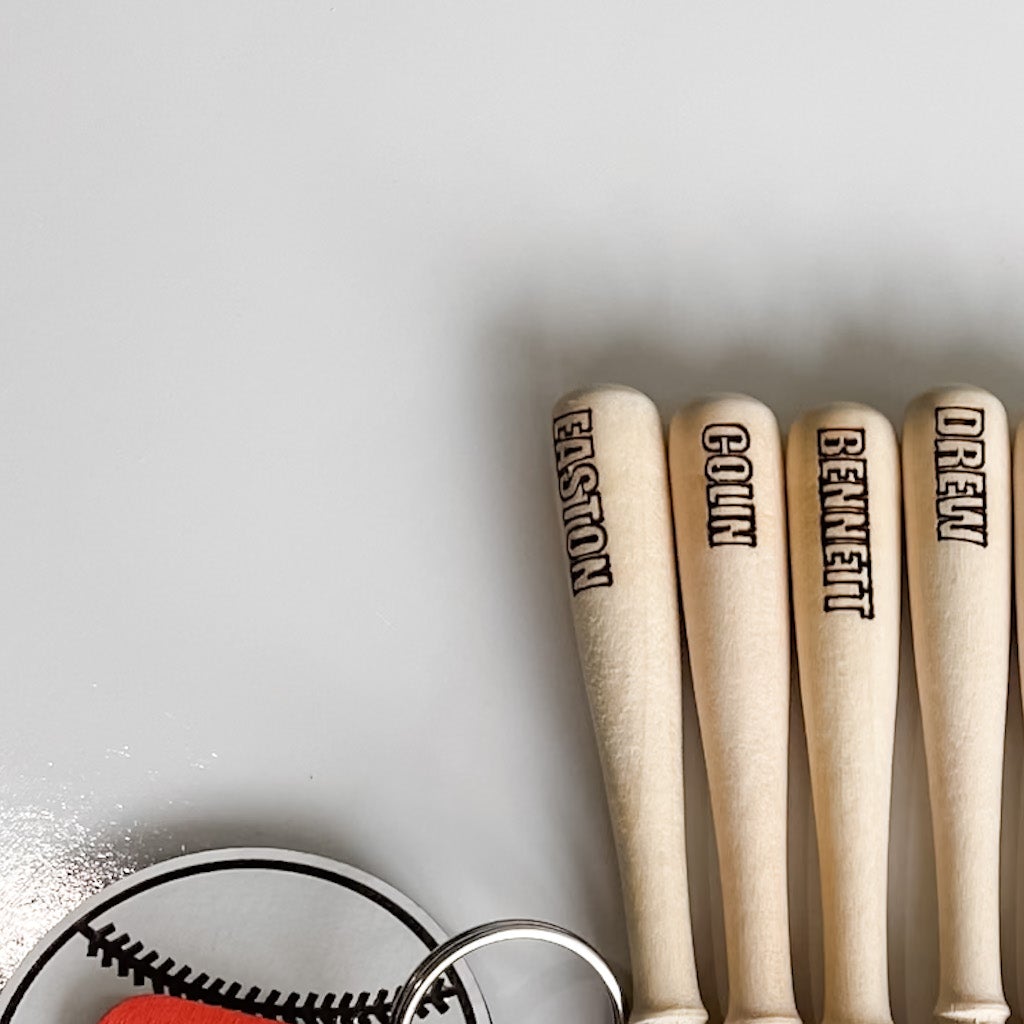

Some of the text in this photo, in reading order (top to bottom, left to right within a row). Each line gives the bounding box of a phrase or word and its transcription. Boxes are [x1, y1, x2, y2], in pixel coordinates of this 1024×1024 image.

[552, 407, 614, 597] EASTON
[702, 423, 757, 548] COLIN
[816, 427, 875, 619] BENNETT
[934, 406, 988, 548] DREW
